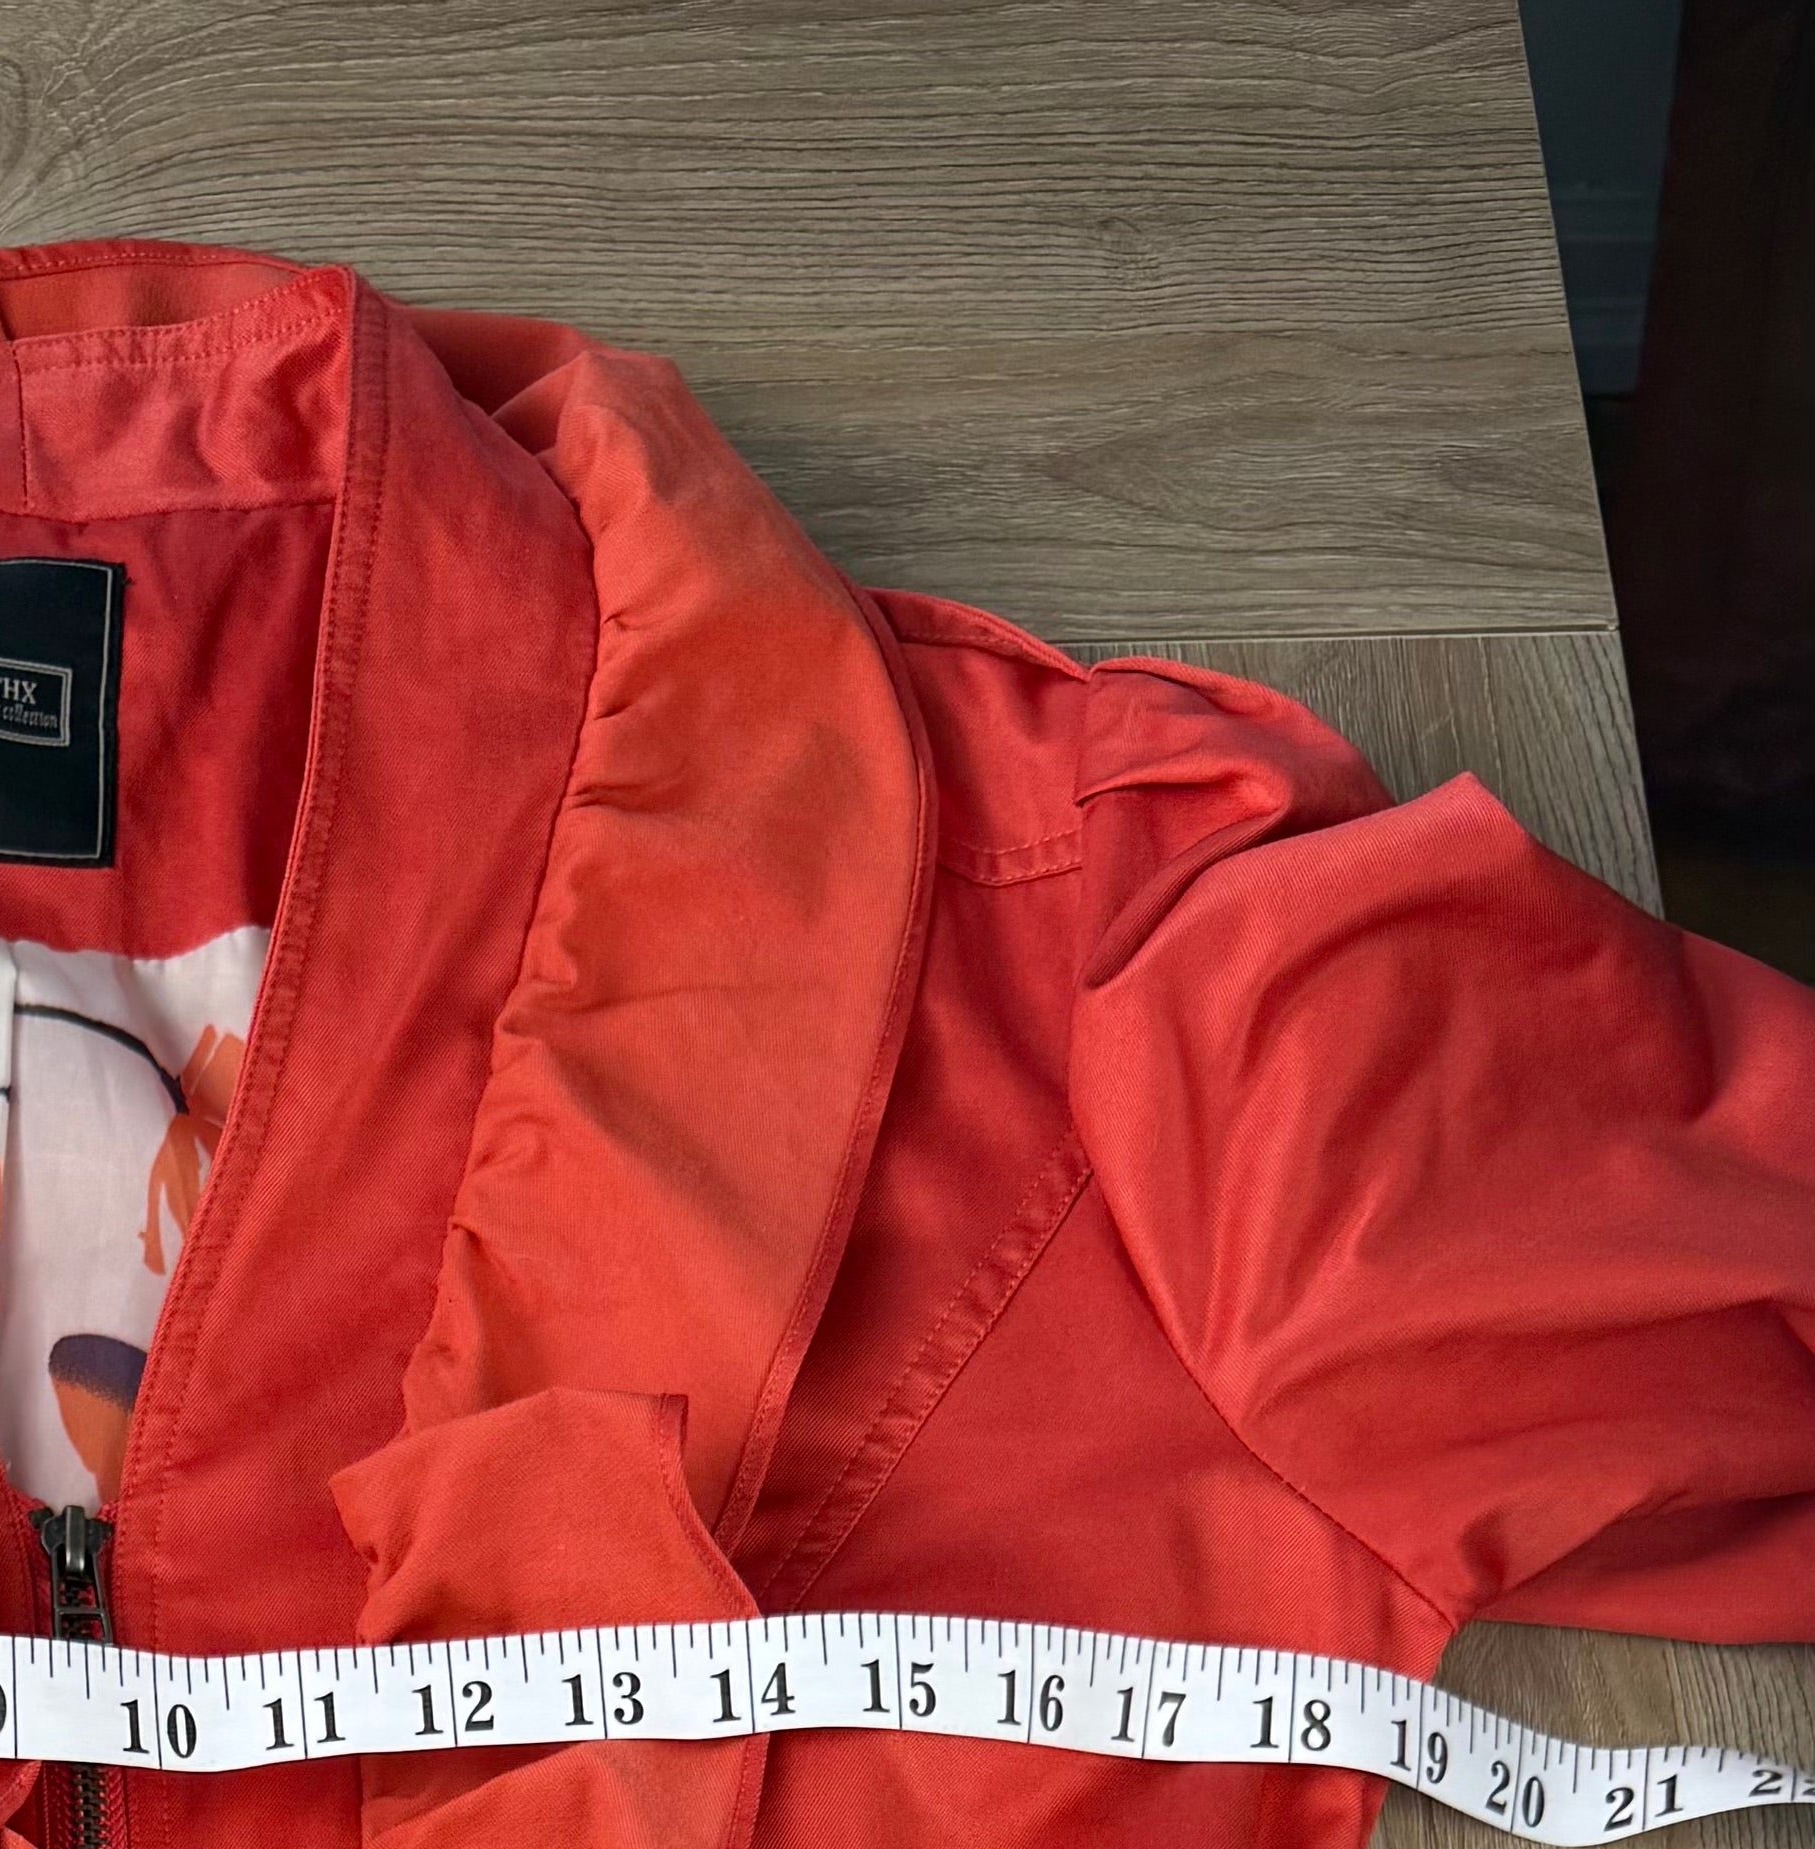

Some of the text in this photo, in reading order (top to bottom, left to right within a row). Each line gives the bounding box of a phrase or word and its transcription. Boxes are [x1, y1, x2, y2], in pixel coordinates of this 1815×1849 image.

[120, 1698, 197, 1759] 10
[262, 1691, 346, 1751] 11
[412, 1680, 495, 1736] 12
[562, 1671, 644, 1727] 13
[710, 1662, 796, 1723] 14
[860, 1658, 937, 1717] 15
[997, 1669, 1065, 1732] 16
[1110, 1686, 1187, 1748] 17
[1250, 1695, 1332, 1752] 18
[1390, 1719, 1449, 1785] 19
[1485, 1759, 1546, 1828] 20
[1604, 1773, 1683, 1832] 21
